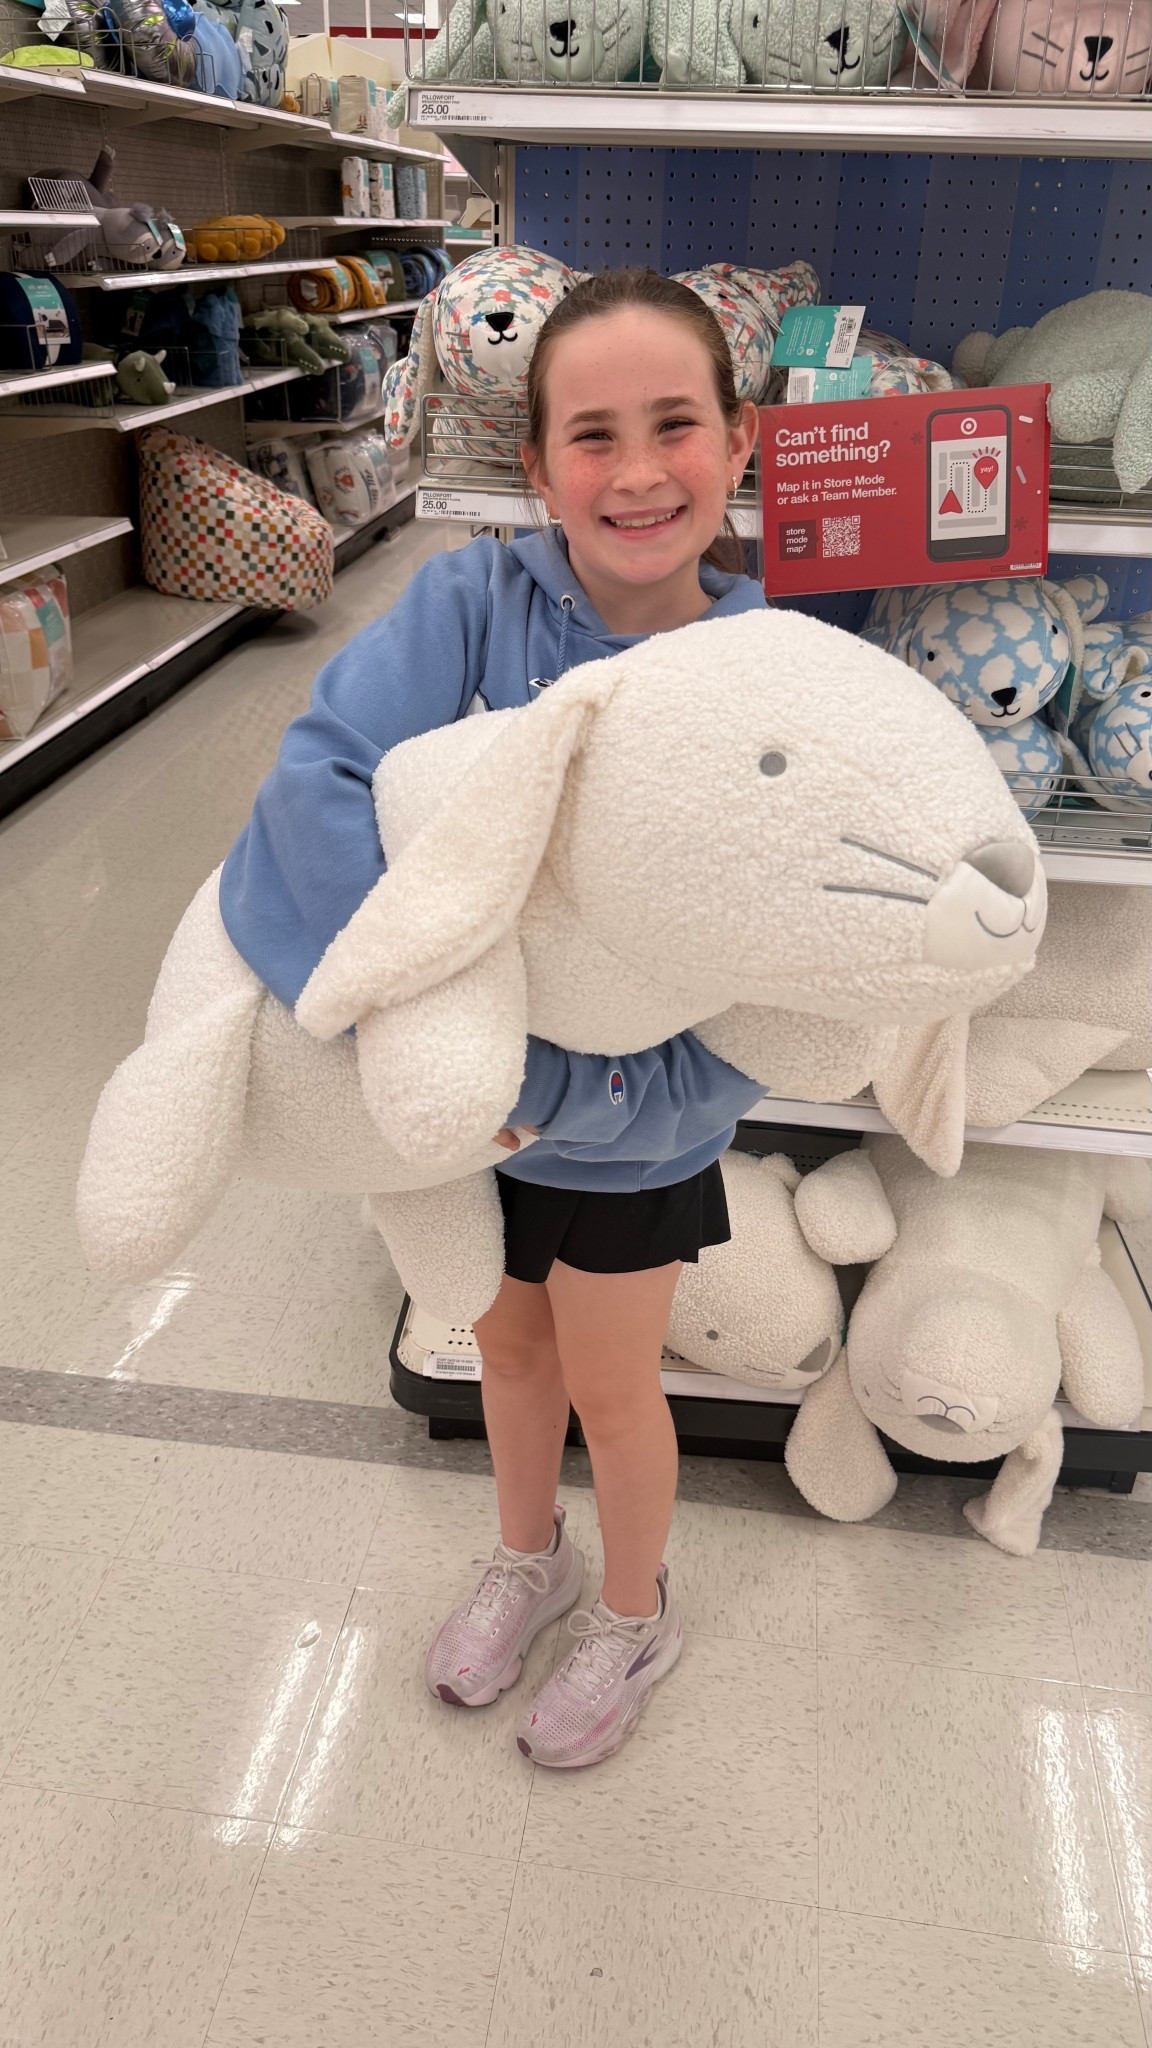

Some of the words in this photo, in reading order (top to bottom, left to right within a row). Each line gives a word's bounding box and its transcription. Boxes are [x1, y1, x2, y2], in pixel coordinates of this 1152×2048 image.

[421, 104, 449, 114] 25.00
[775, 426, 827, 447] Can't
[830, 421, 869, 442] find
[775, 440, 891, 467] something?
[980, 465, 994, 474] yay!
[777, 482, 800, 493] Map
[802, 480, 810, 490] it
[811, 479, 821, 490] in
[823, 478, 852, 488] Store
[854, 474, 885, 485] Mode
[777, 496, 788, 505] or
[790, 494, 809, 504] ask
[811, 494, 819, 502] a
[821, 491, 849, 501] Team
[851, 487, 897, 499] Member.
[422, 500, 447, 509] 25.00
[786, 528, 806, 536] store
[786, 536, 808, 544] mode
